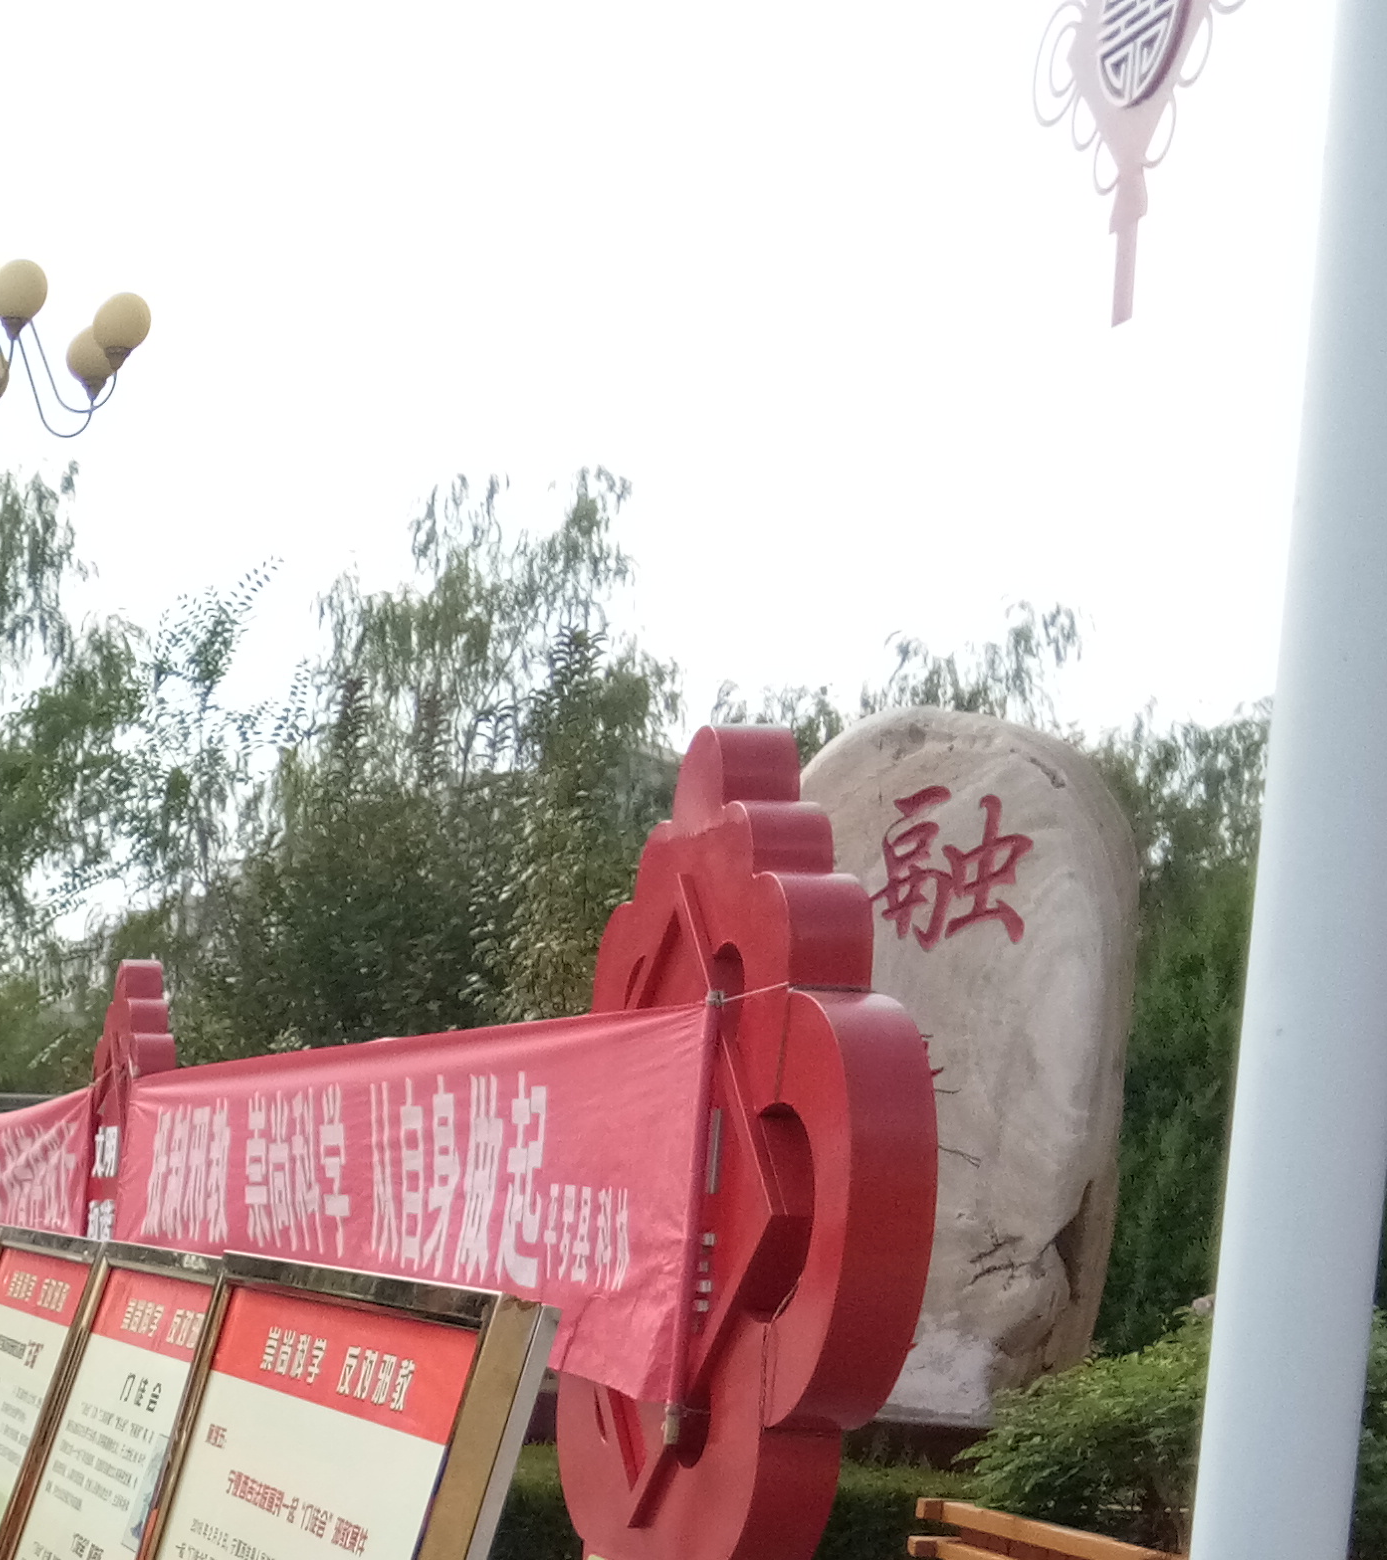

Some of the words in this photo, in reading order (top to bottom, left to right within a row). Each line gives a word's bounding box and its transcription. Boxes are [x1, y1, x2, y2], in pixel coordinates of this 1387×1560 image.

[870, 785, 1033, 952] 融
[244, 1082, 350, 1258] 崇尚科学
[369, 1070, 549, 1290] 从自身做起
[121, 1298, 165, 1337] 崇尚科学
[259, 1326, 327, 1385] 崇尚科学
[336, 1346, 416, 1412] 反对邪教
